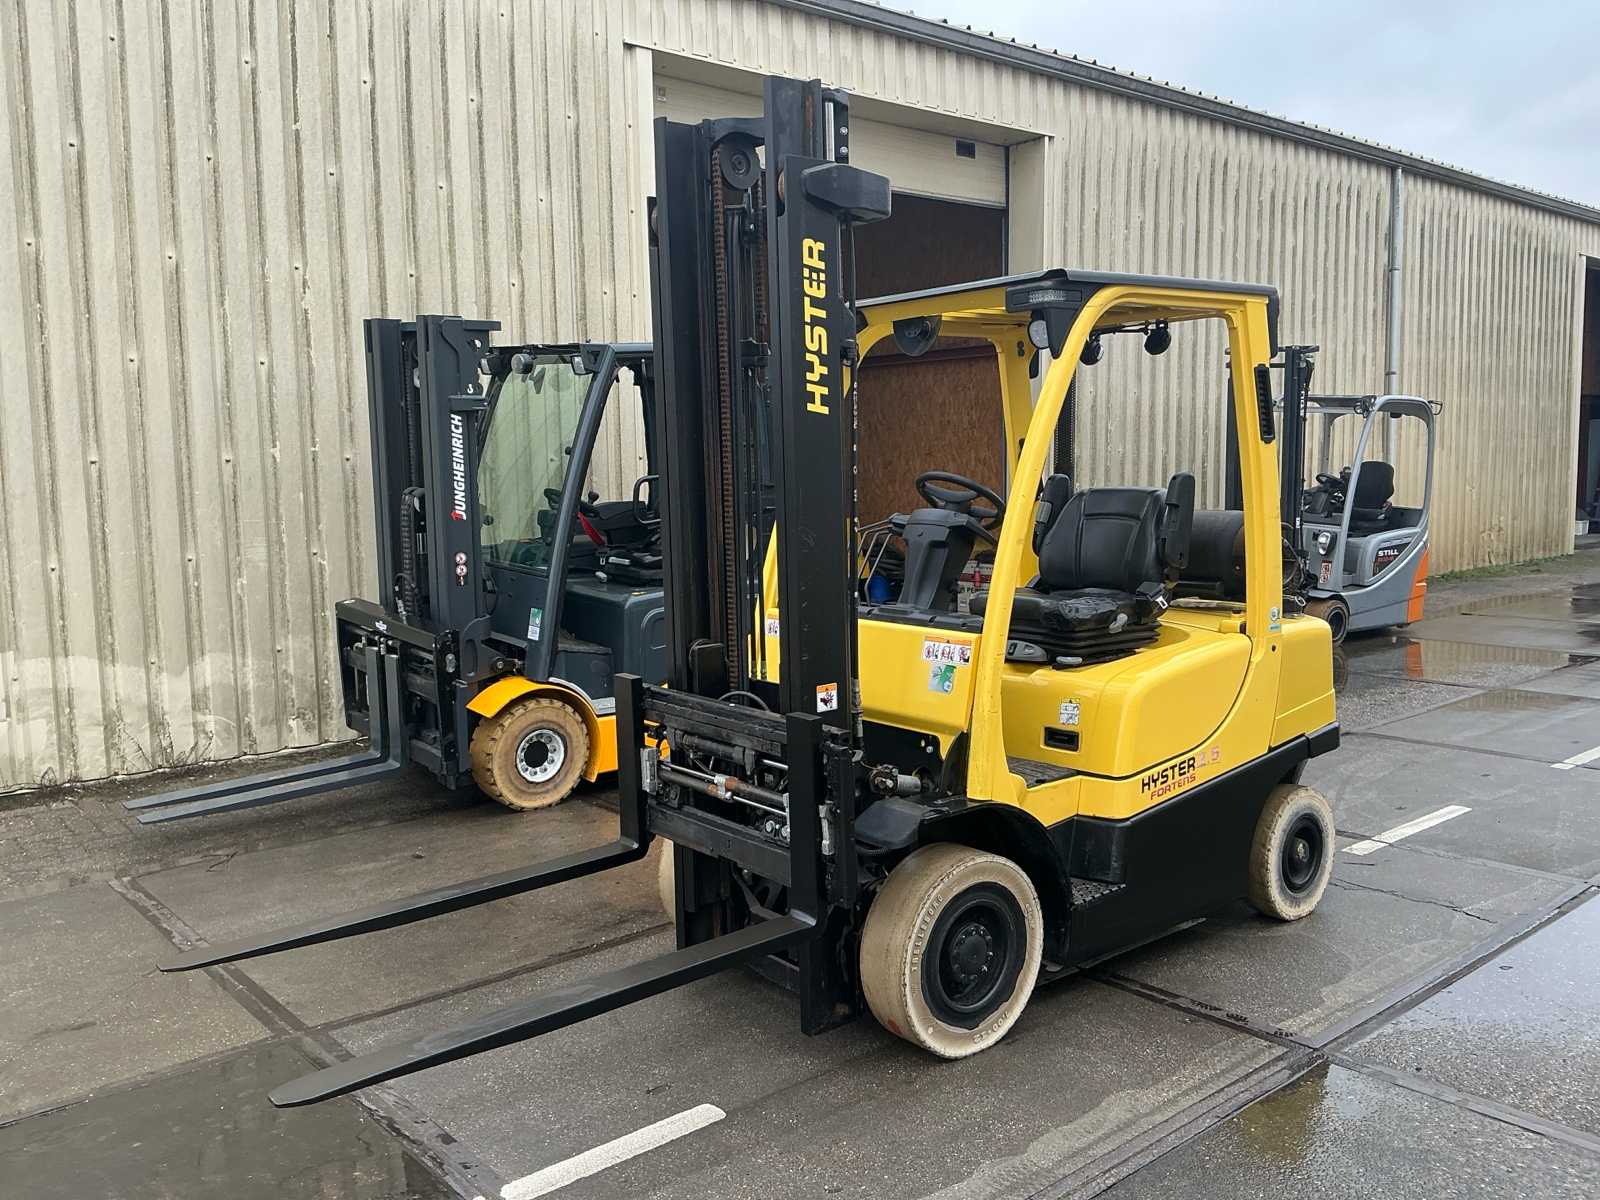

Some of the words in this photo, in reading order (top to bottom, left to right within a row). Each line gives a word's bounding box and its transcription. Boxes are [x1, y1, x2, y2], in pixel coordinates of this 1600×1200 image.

[802, 237, 830, 415] HYSTER
[450, 413, 467, 520] JUNGHEINRICH
[1378, 549, 1399, 557] STILL
[1141, 756, 1196, 794] HYSTER
[1150, 773, 1196, 801] FORTENS
